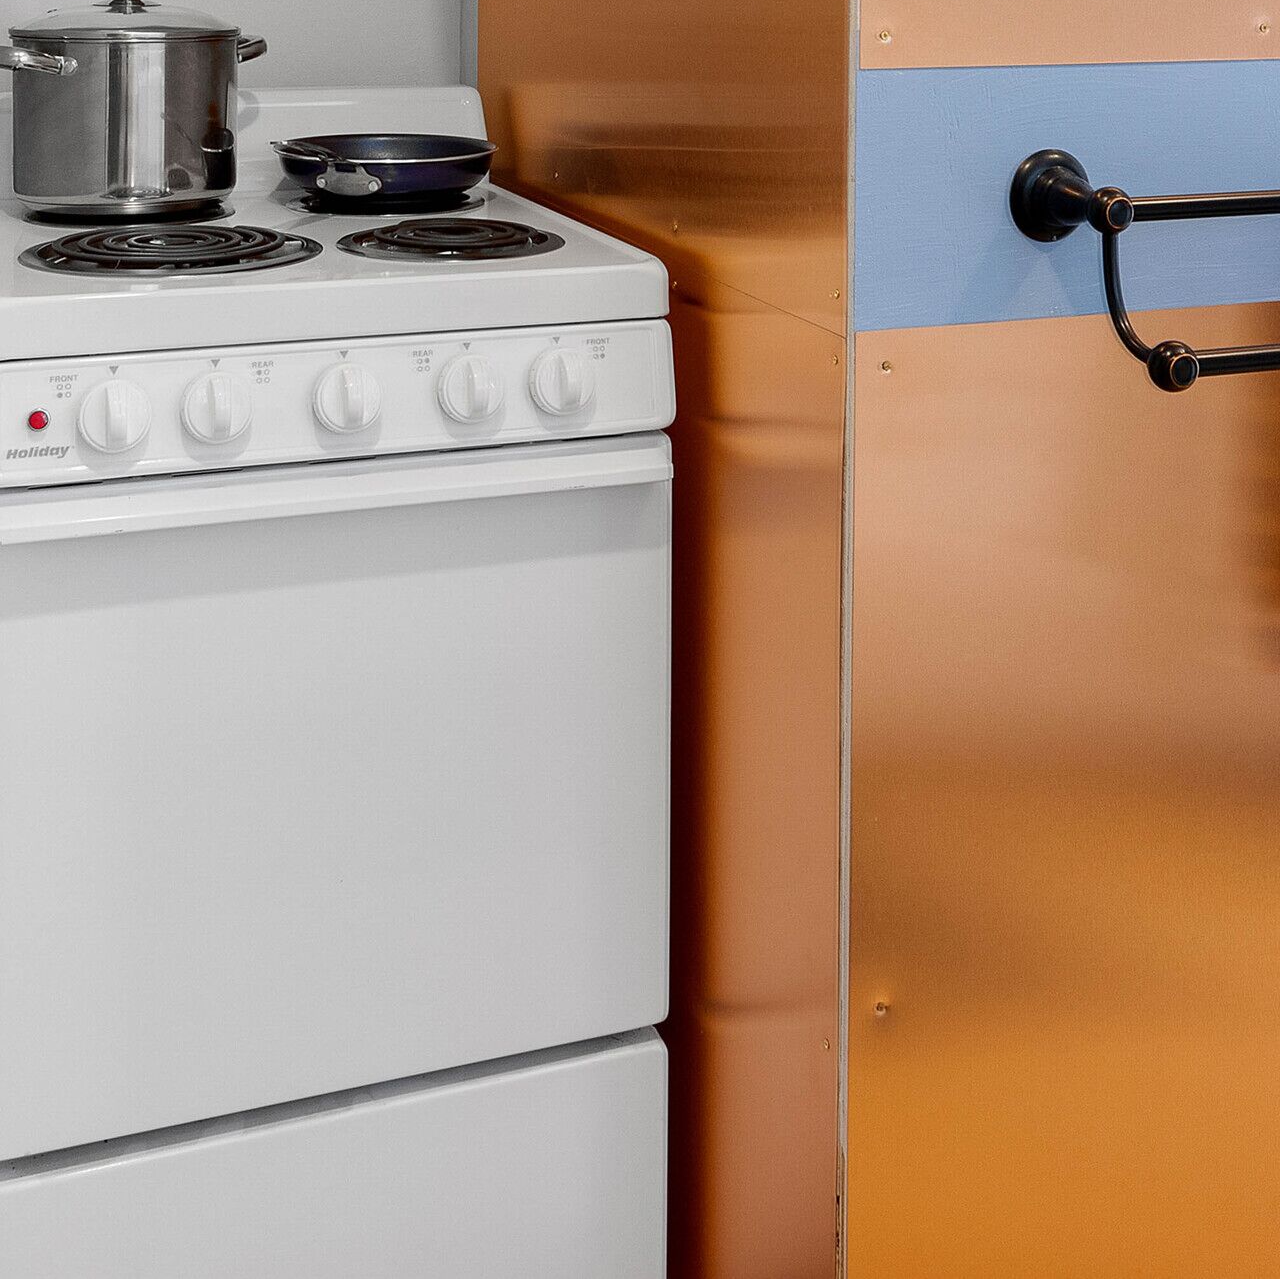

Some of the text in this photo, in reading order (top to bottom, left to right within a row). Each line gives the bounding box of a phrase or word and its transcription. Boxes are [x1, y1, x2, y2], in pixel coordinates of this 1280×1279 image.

[586, 337, 610, 345] FRONT
[412, 349, 433, 357] REAR
[251, 360, 274, 368] REAR
[49, 374, 79, 383] FRONT
[6, 446, 70, 460] Holiday
